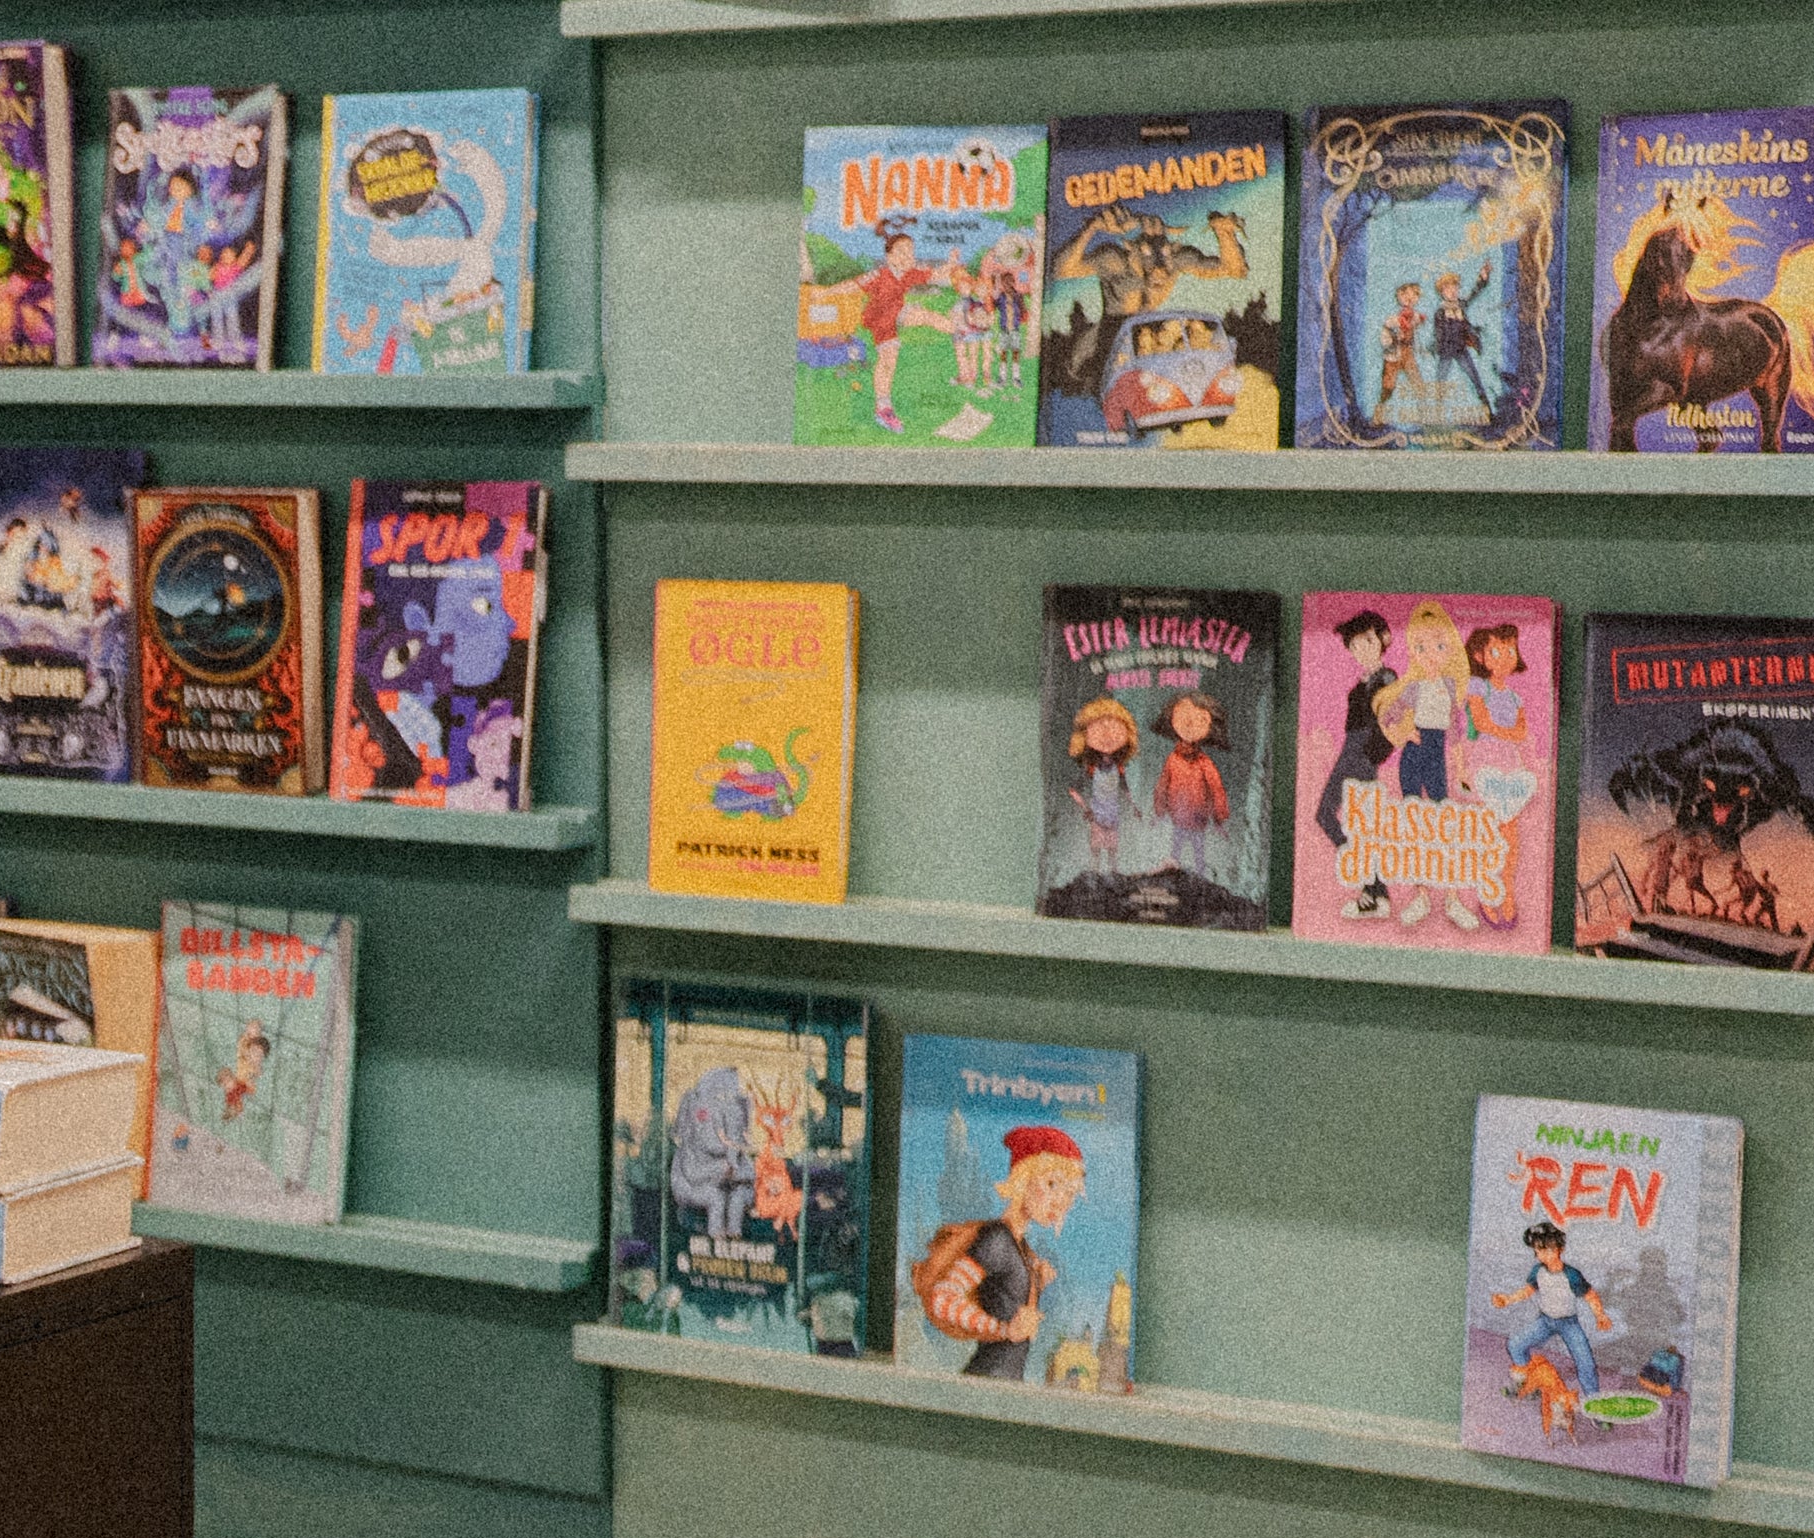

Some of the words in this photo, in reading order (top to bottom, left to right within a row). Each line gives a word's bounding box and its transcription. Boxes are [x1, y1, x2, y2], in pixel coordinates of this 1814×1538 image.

[1064, 143, 1267, 208] GEDEMANDEN
[1634, 128, 1809, 168] Måneskins
[840, 154, 1013, 230] NANNA
[1652, 169, 1792, 201] rytterne
[370, 511, 490, 564] SPOR
[1702, 701, 1814, 721] EKSPERIMEN
[1345, 782, 1499, 849] Klassens
[676, 840, 764, 860] PATRICK
[1339, 842, 1506, 903] dronning
[1520, 1154, 1666, 1230] REN
